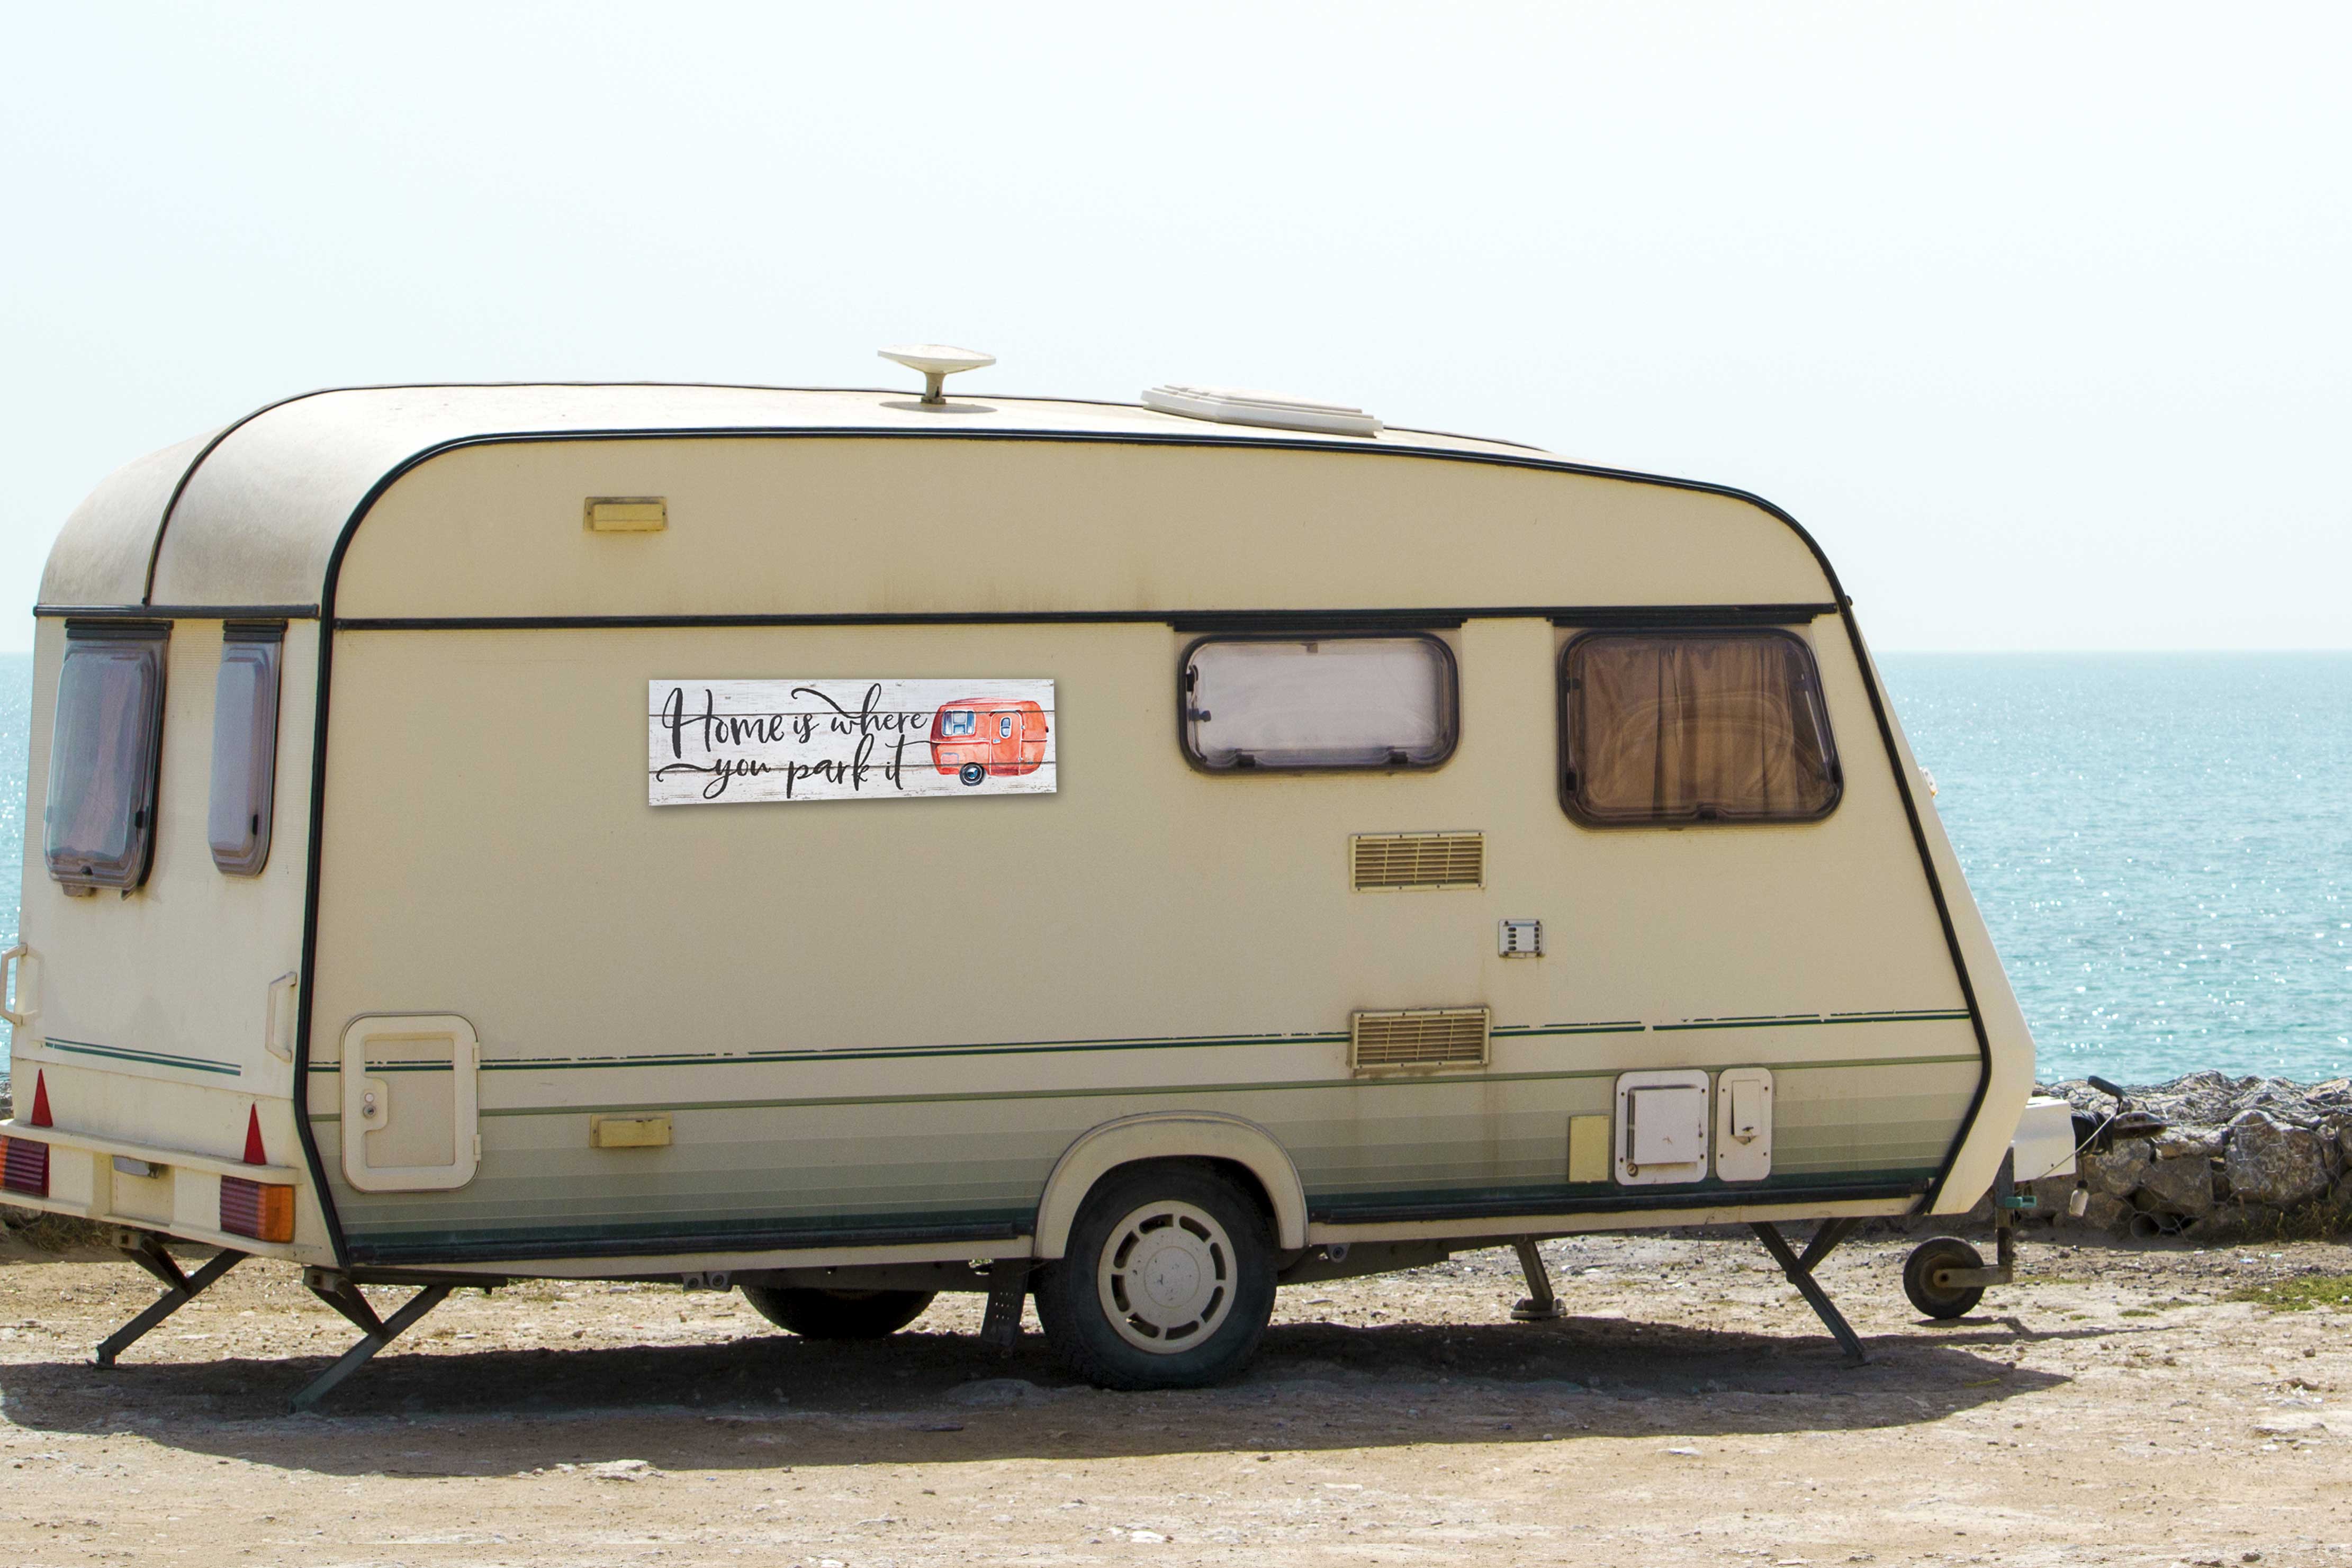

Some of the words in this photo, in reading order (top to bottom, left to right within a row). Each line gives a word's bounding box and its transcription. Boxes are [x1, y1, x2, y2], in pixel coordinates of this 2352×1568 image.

[662, 687, 785, 759] Home
[791, 682, 928, 736] where
[793, 714, 819, 744] is
[656, 756, 771, 799] you
[787, 733, 870, 798] park
[885, 734, 931, 790] it
